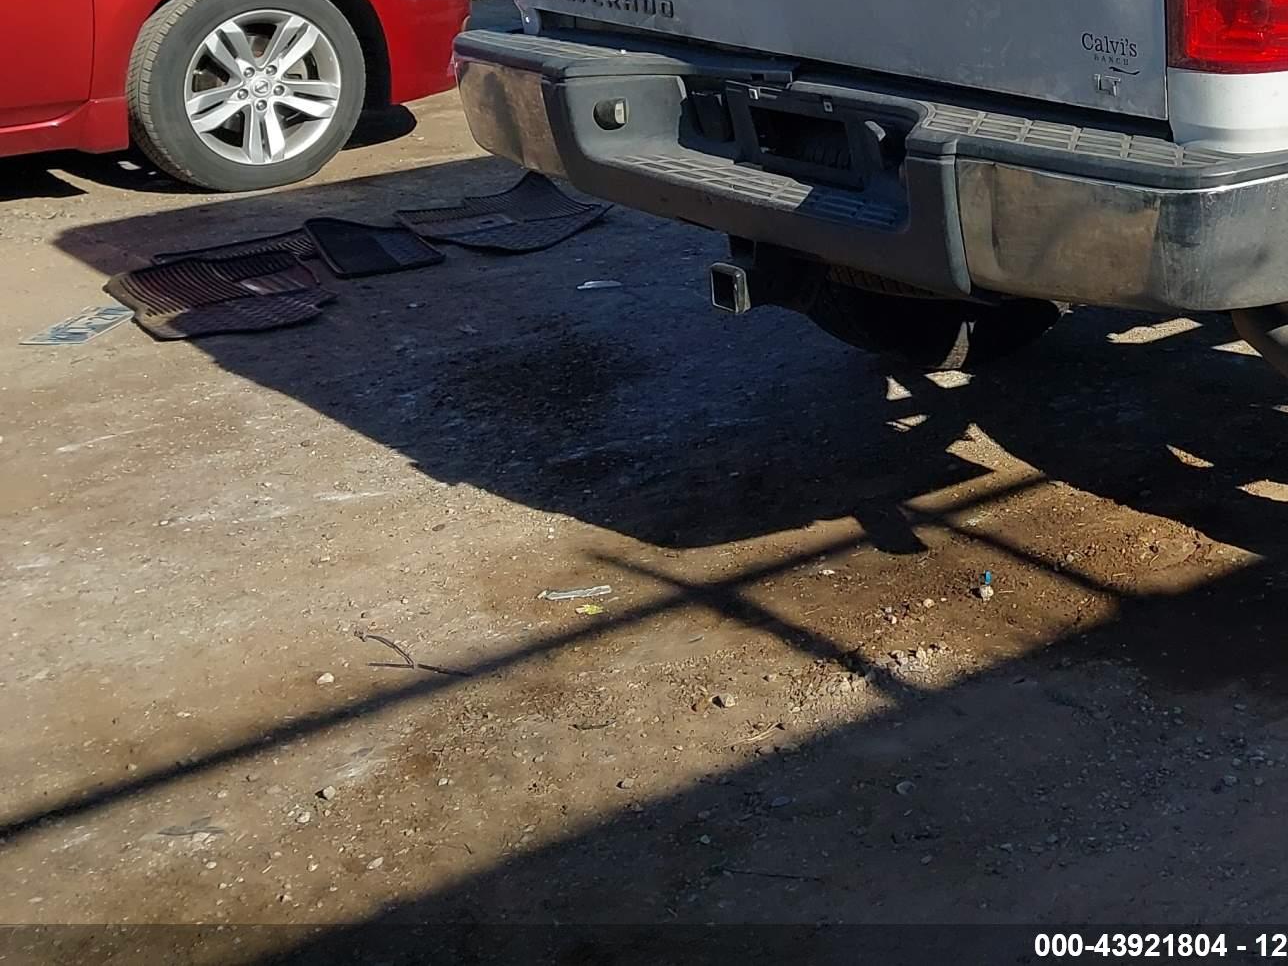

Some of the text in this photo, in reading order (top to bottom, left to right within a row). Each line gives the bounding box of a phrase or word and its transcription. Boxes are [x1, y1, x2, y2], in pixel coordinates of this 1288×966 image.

[1082, 33, 1137, 57] Calvi's
[1094, 56, 1129, 66] RANCH
[1093, 73, 1122, 98] LT
